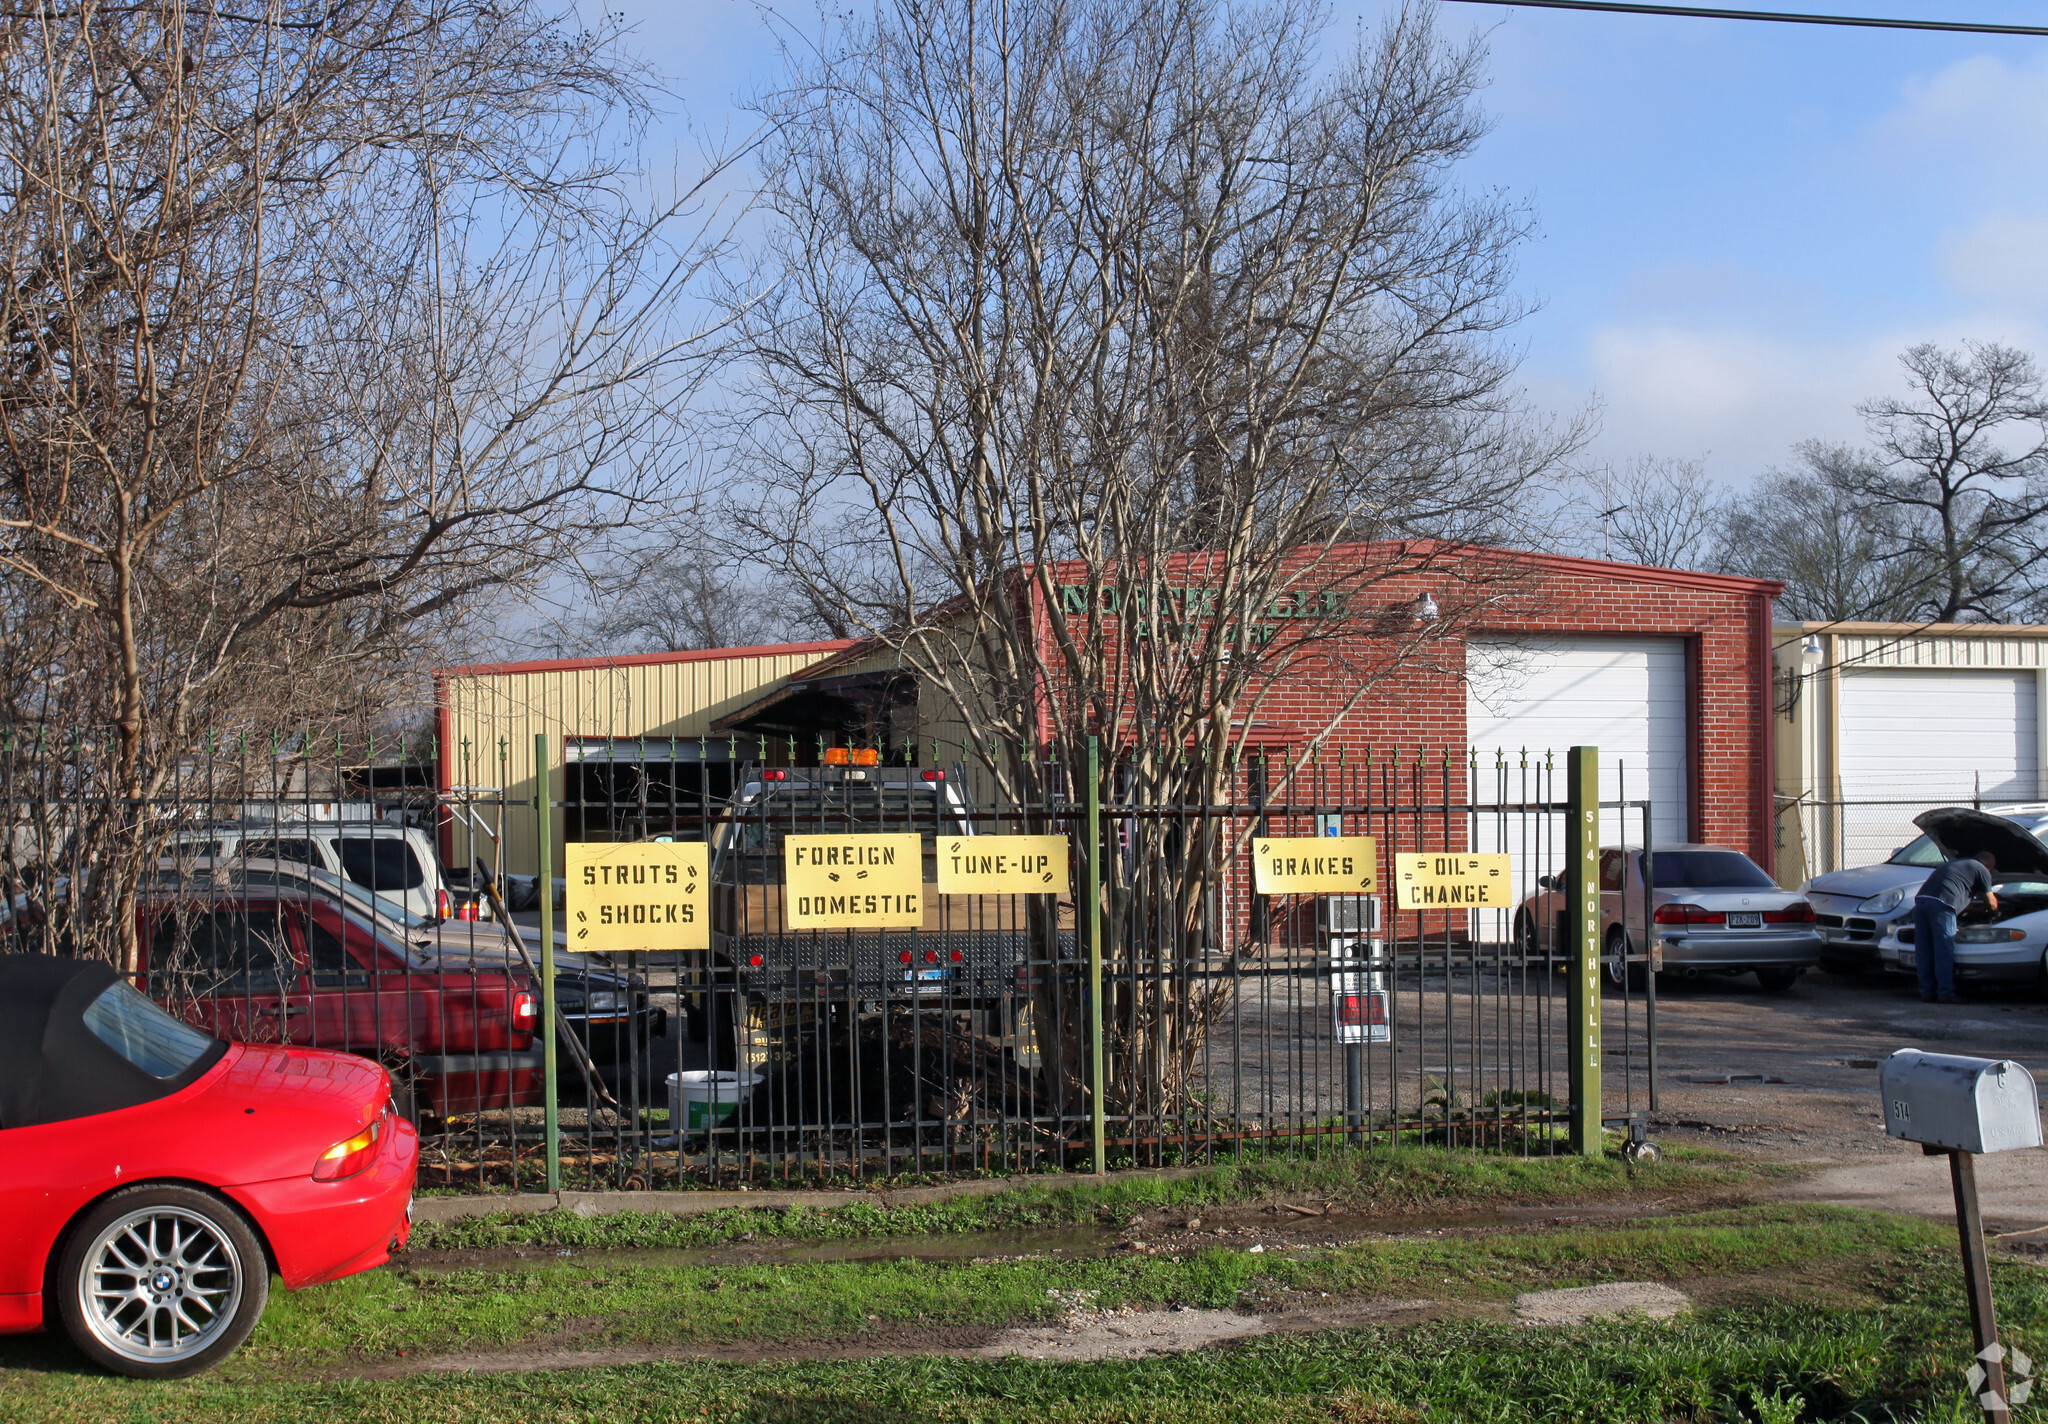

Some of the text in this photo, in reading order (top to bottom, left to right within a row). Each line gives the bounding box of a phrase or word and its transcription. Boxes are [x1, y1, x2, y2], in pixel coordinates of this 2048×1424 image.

[1586, 810, 1595, 861] 514
[796, 847, 894, 865] FOREIGN
[951, 856, 1048, 874] TUNE-UP
[584, 866, 678, 884] STRUTS
[1272, 858, 1353, 875] BRAKES
[1435, 858, 1465, 875] OIL
[1411, 885, 1489, 903] CHANGE
[800, 895, 917, 914] DOMESTIC
[601, 905, 694, 923] SHOCKS
[1587, 881, 1597, 1066] NORTHVILLE
[1895, 1101, 1909, 1120] 514
